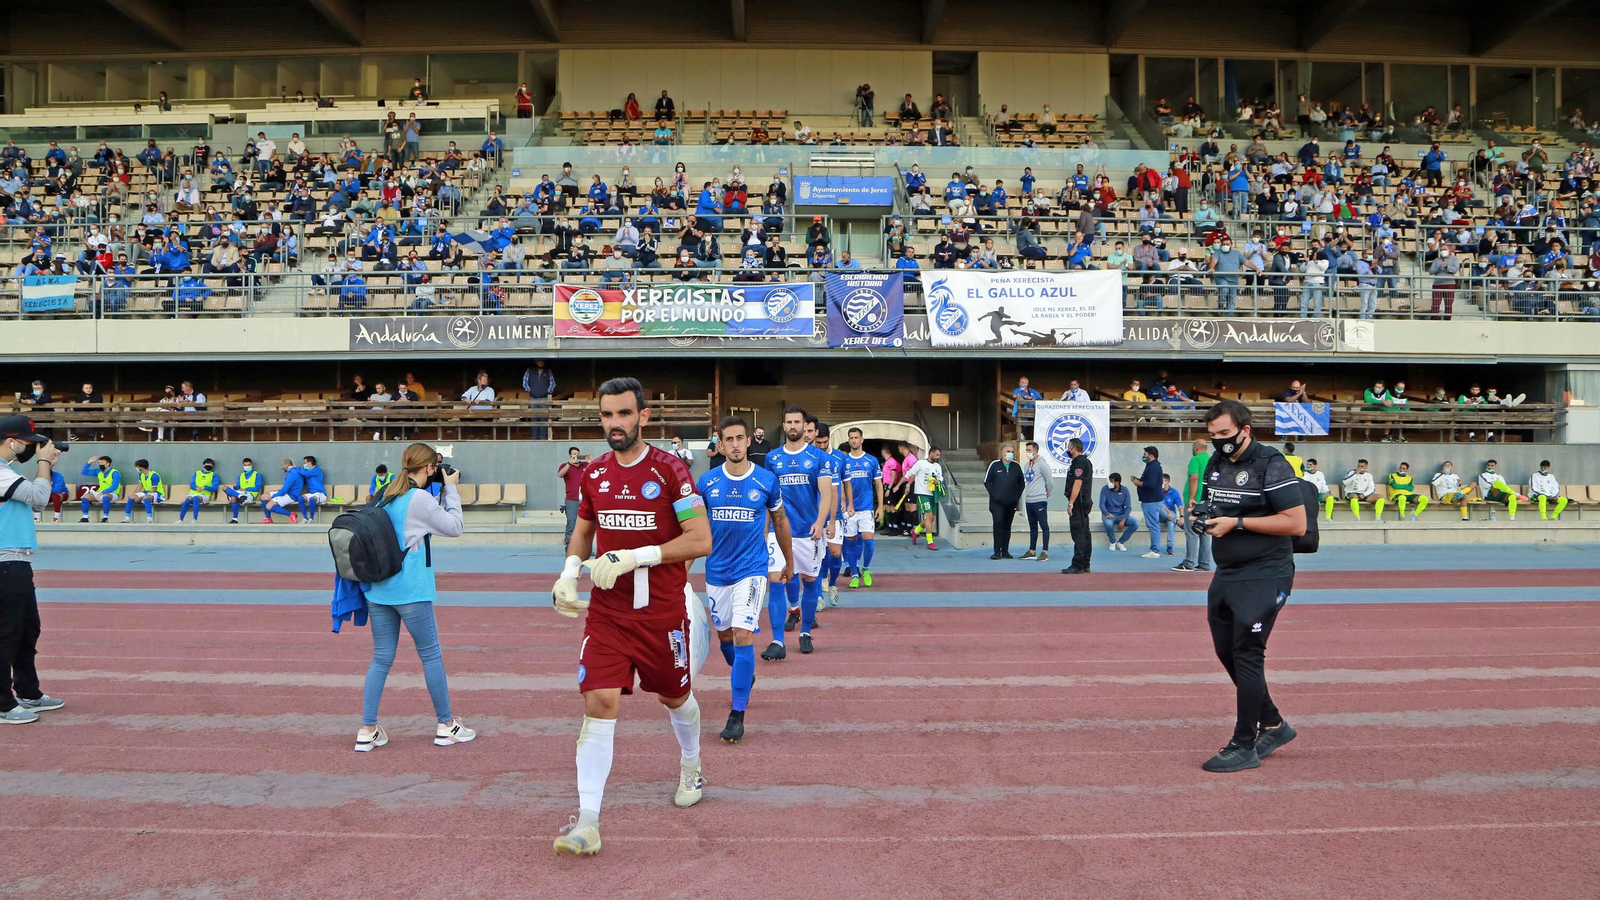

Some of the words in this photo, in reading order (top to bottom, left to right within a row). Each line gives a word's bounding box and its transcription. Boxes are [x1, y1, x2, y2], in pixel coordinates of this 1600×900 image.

[622, 288, 745, 306] XERECISTAS
[967, 288, 984, 299] EL
[988, 288, 1035, 299] GALLO
[1040, 287, 1077, 298] AZUL
[574, 302, 599, 310] XEREZ
[621, 309, 654, 322] POR
[660, 309, 678, 322] EL
[680, 309, 745, 322] MUNDO
[355, 323, 442, 344] Andalucía
[1222, 323, 1309, 345] Andalucía
[842, 336, 874, 345] XEREZ
[875, 336, 888, 345] DFC
[597, 513, 656, 528] RANABE
[712, 509, 755, 520] RANABE
